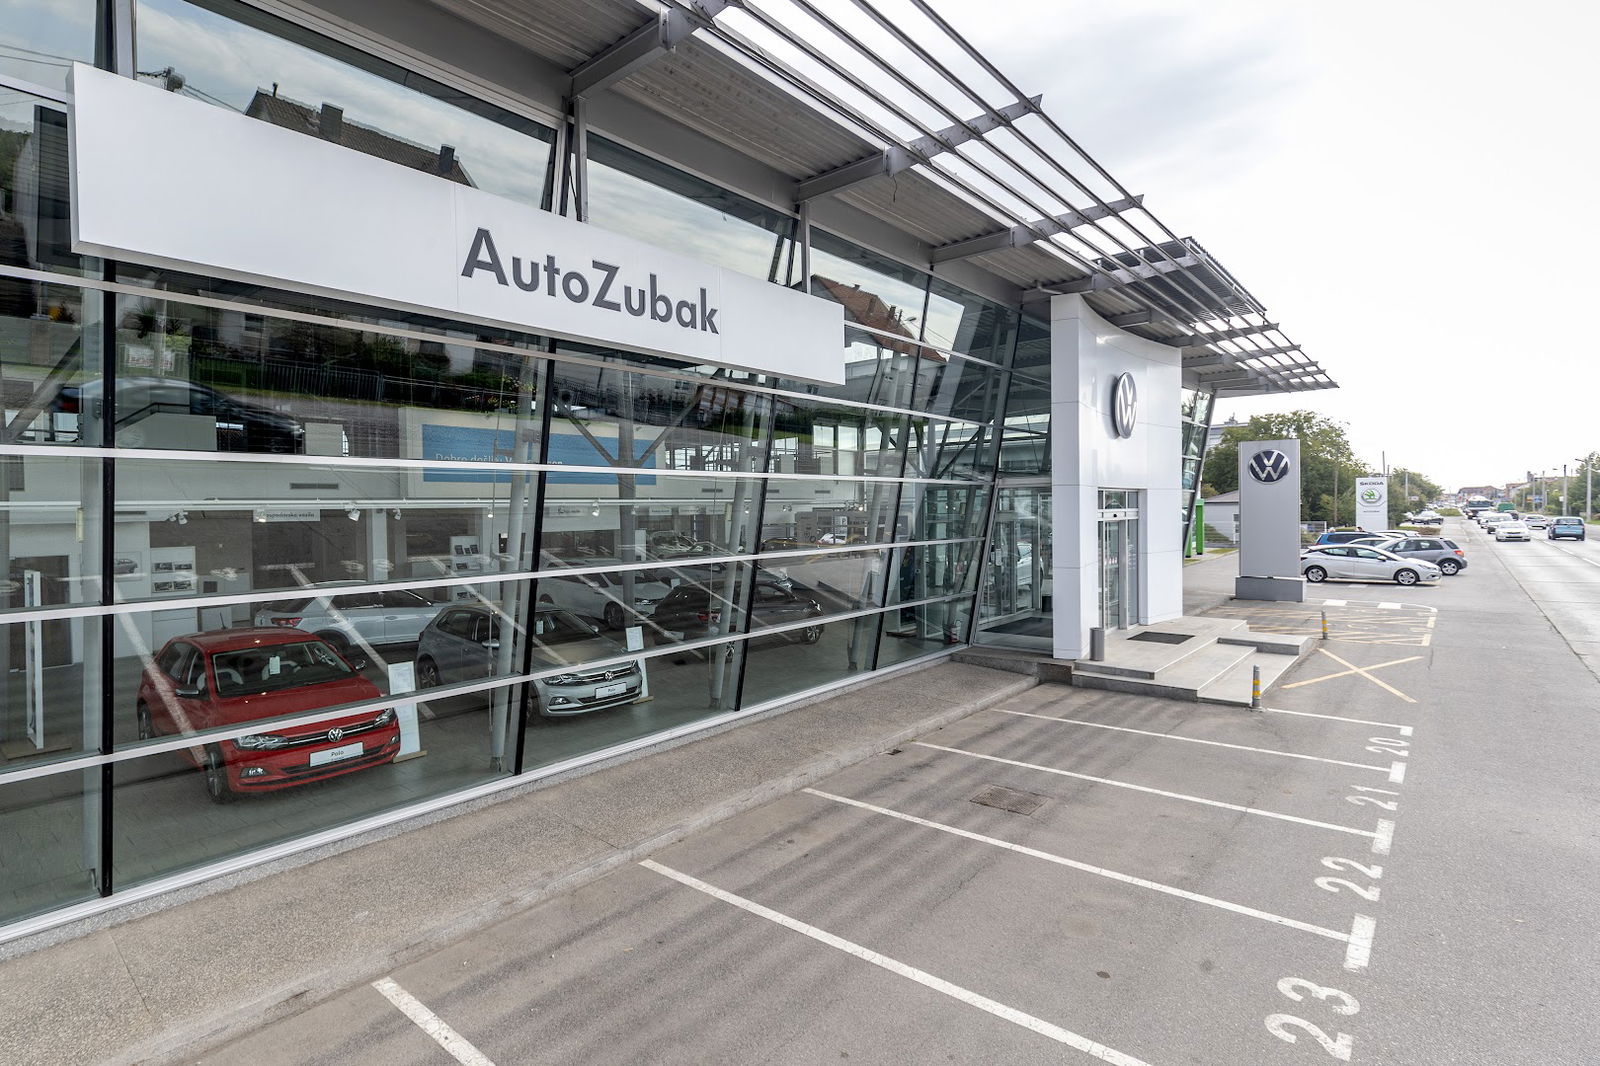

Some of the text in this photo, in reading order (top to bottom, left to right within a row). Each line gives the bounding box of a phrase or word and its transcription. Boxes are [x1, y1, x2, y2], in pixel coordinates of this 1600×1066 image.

[461, 227, 719, 335] AutoZubak
[1248, 450, 1290, 485] VW
[1365, 737, 1410, 757] 20
[1345, 784, 1400, 811] 21
[1314, 856, 1383, 902] 22
[1264, 977, 1360, 1061] 23
